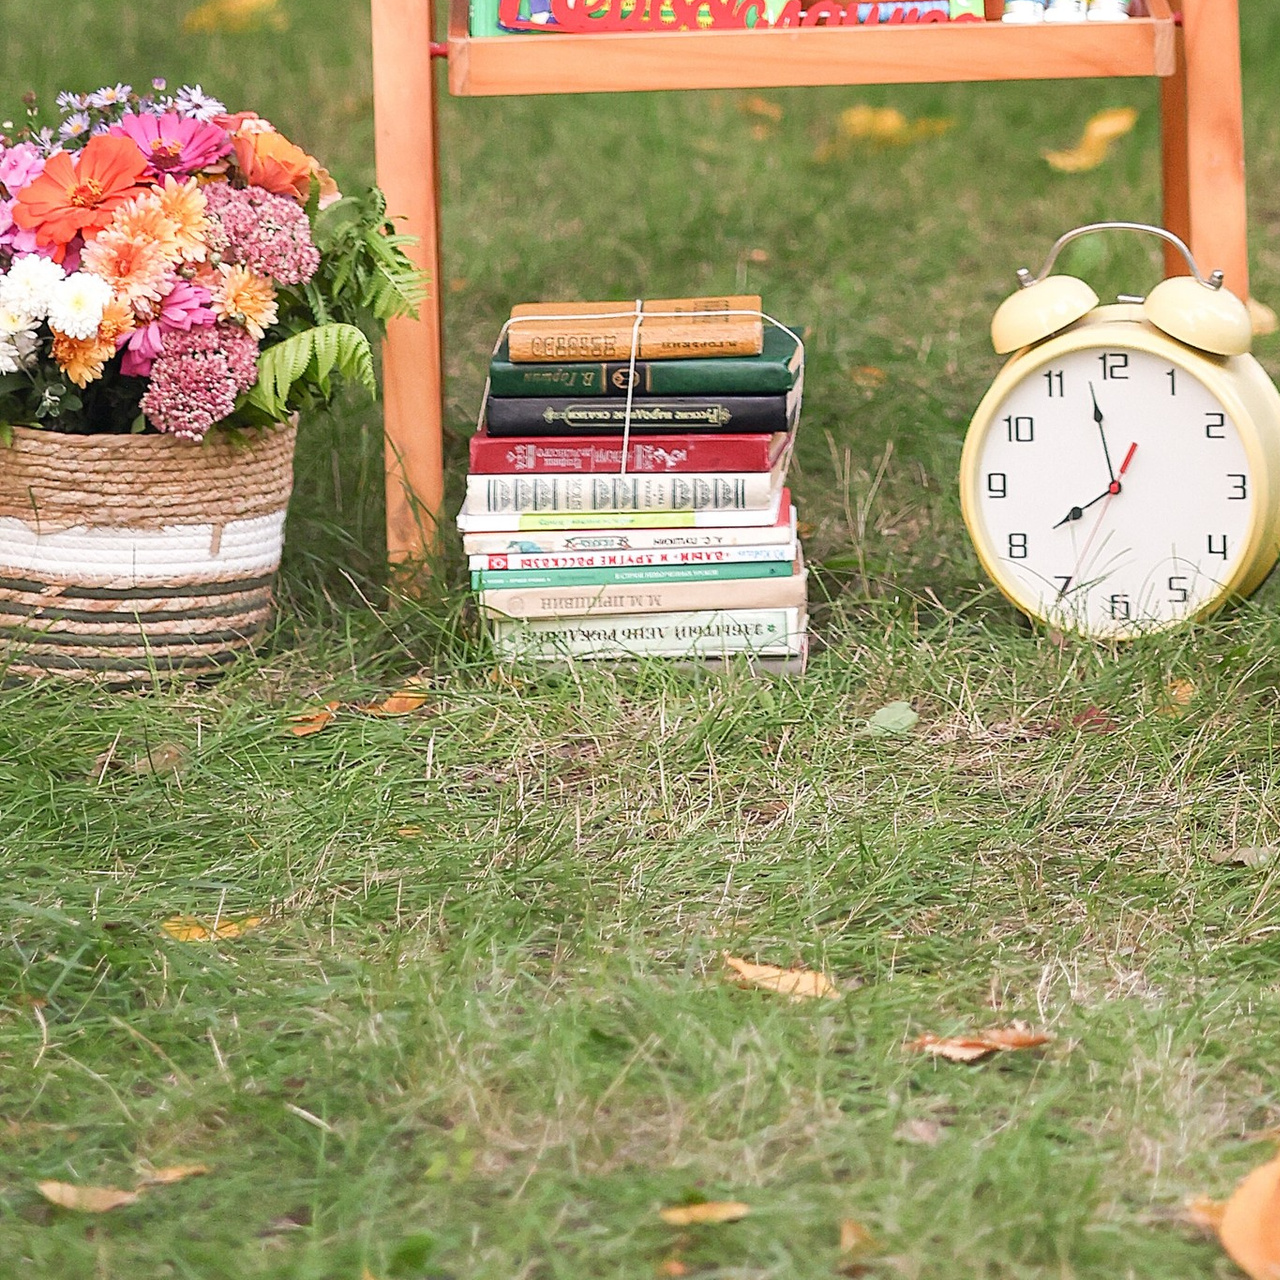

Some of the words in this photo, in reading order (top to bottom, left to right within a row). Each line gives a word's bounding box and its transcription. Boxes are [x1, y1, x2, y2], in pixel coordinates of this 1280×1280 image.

[1099, 354, 1128, 379] 12
[1043, 370, 1064, 397] 11
[1166, 369, 1176, 395] 1
[1003, 416, 1034, 442] 10
[1205, 413, 1225, 439] 2
[988, 473, 1007, 498] 9
[1227, 474, 1247, 500] 3
[1008, 533, 1028, 558] 8
[1208, 534, 1229, 560] 4
[1169, 576, 1188, 603] 5
